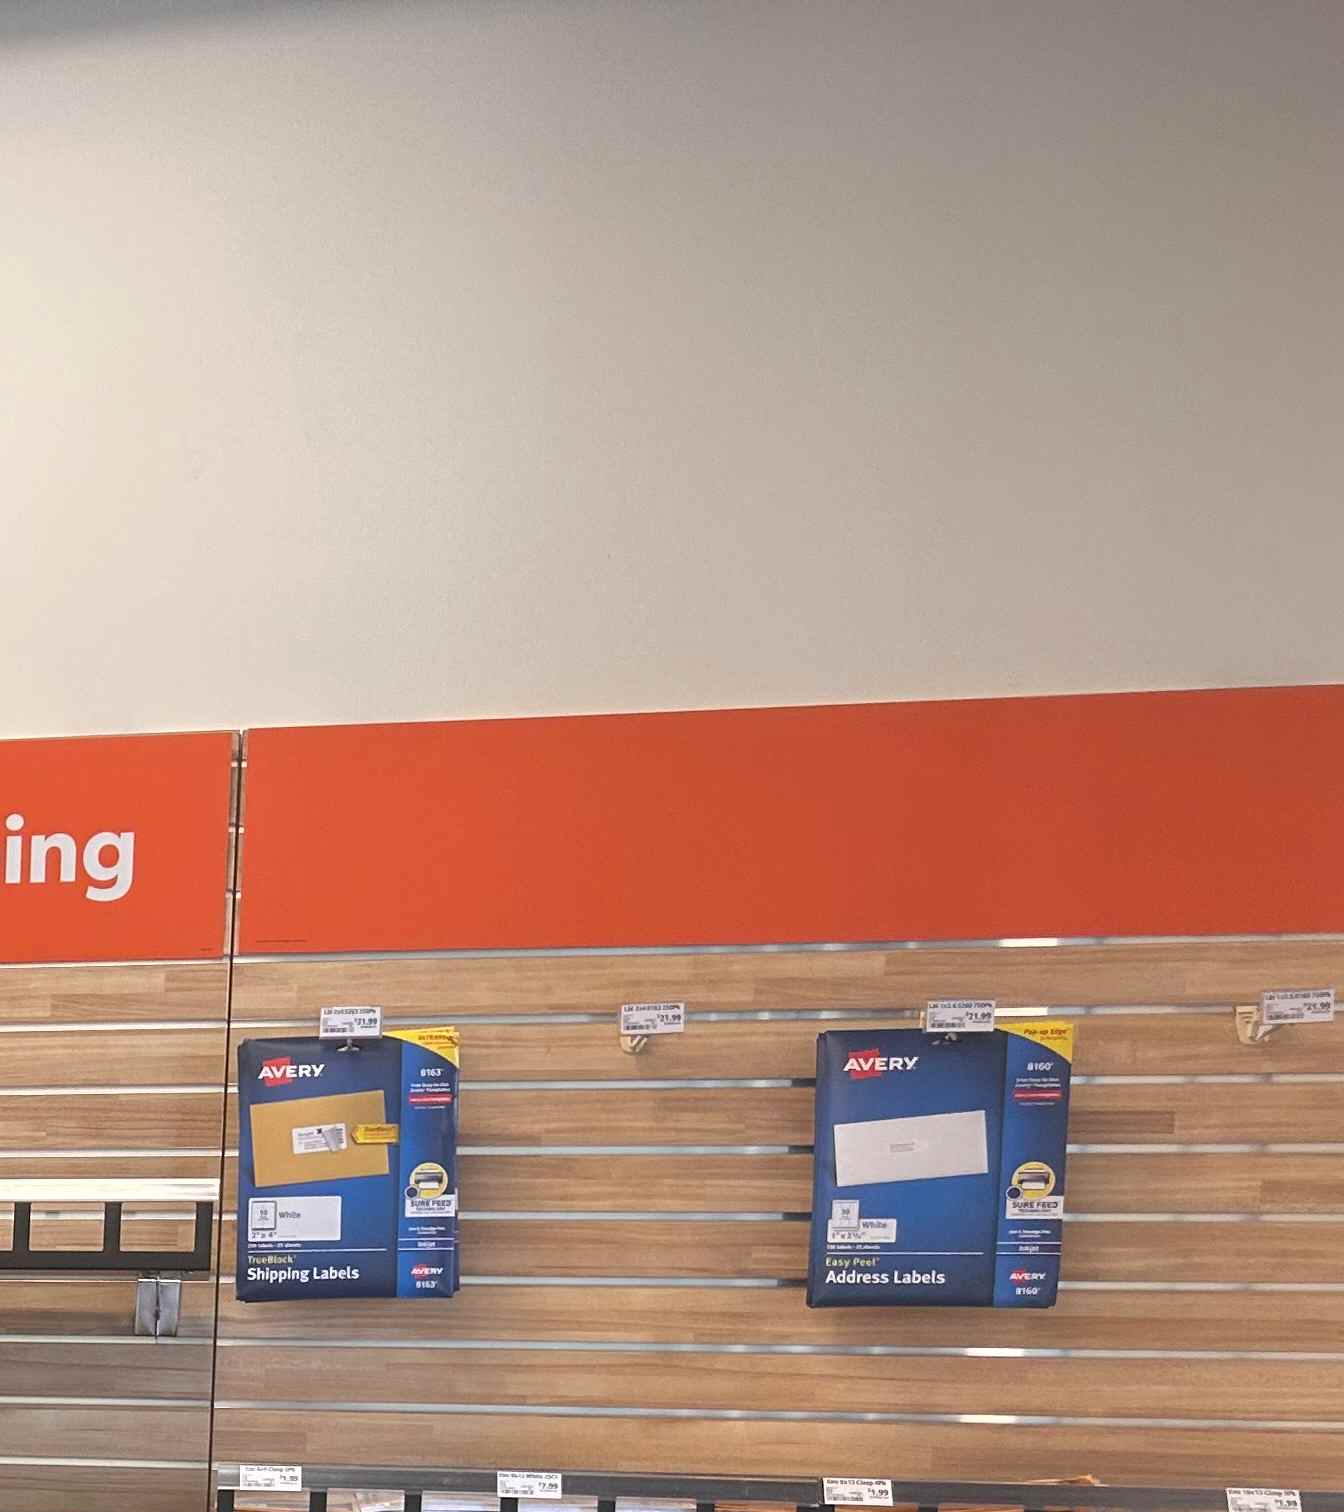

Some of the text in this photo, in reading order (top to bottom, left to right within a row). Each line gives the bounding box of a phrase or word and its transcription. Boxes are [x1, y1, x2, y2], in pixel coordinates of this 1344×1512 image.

[842, 1056, 919, 1072] AVERY
[258, 1063, 326, 1079] AVERY
[278, 1210, 301, 1219] White
[861, 1221, 888, 1230] White
[825, 1257, 846, 1268] Easy
[247, 1266, 360, 1283] Shipping Labels
[411, 1266, 443, 1276] AVERY
[825, 1269, 946, 1284] Address Labels
[1009, 1272, 1046, 1281] AVERY
